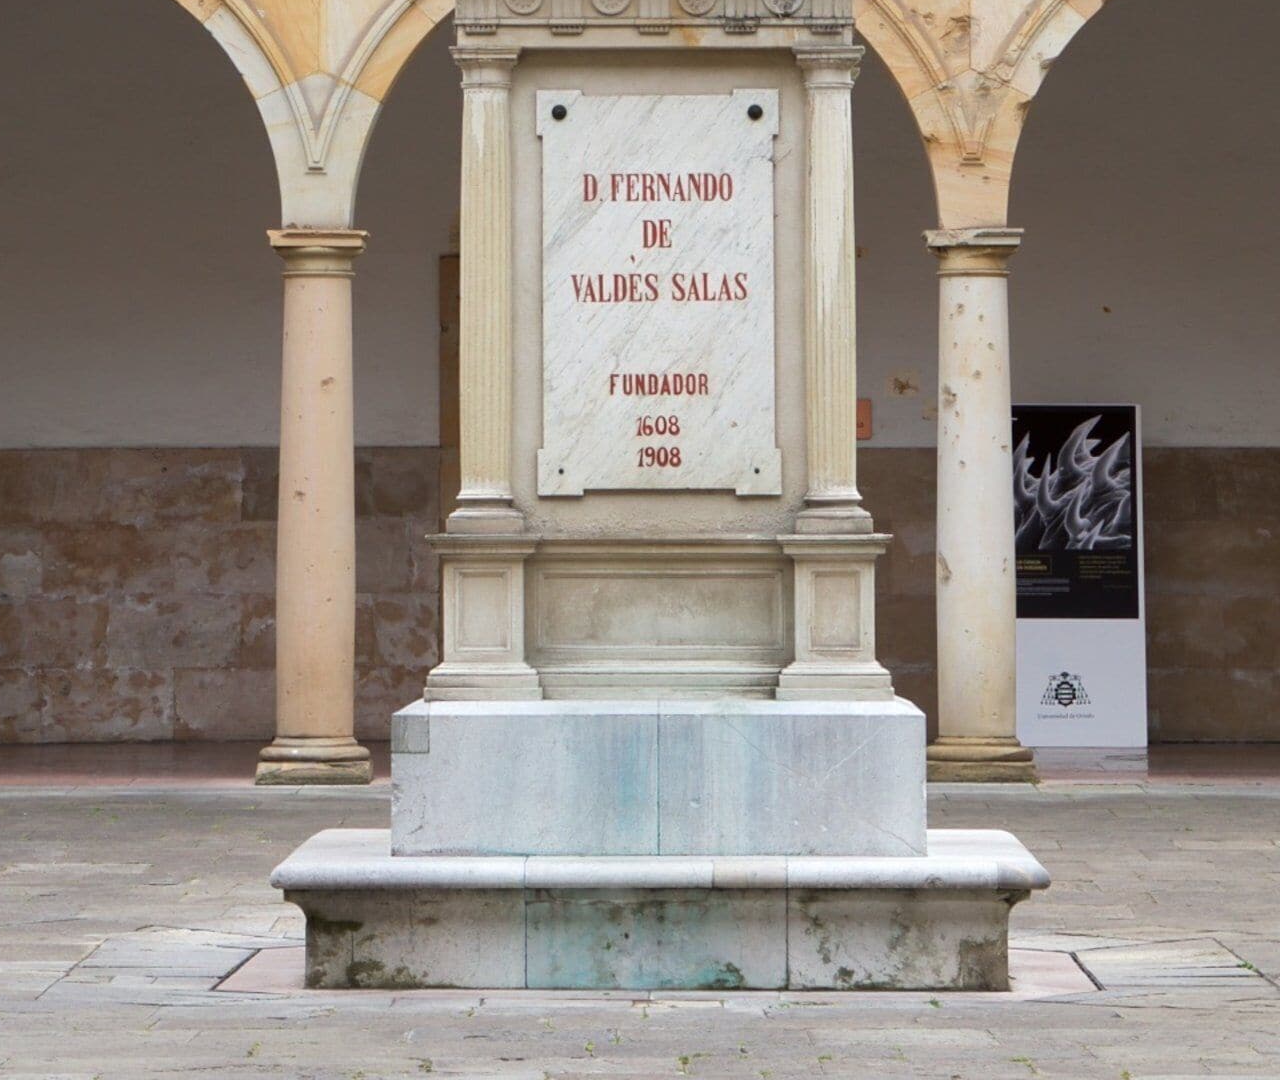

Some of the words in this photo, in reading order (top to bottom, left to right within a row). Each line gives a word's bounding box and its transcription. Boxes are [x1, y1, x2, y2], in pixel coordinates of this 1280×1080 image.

[583, 174, 604, 203] D.
[610, 173, 734, 203] FERNANDO
[642, 219, 673, 249] DE
[671, 272, 749, 302] SALAS
[609, 373, 710, 396] FUNDADOR
[635, 415, 681, 436] 1608
[636, 446, 682, 468] 1908
